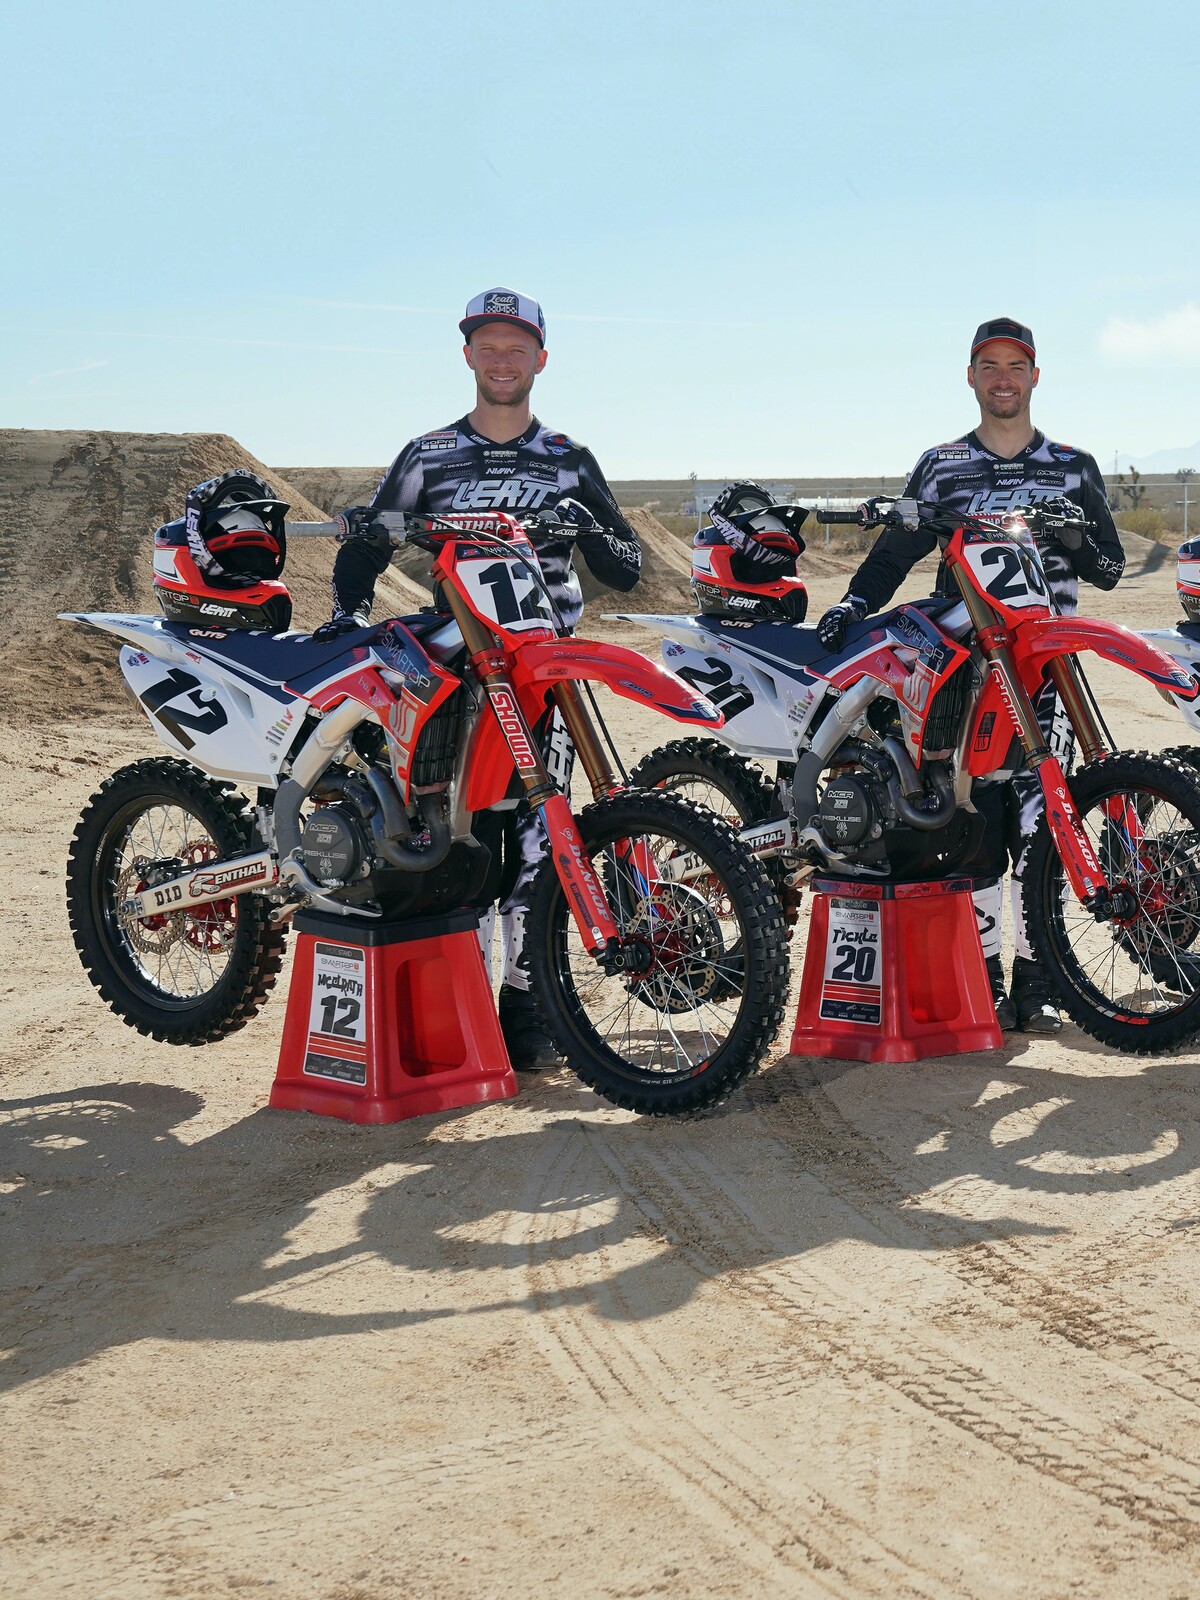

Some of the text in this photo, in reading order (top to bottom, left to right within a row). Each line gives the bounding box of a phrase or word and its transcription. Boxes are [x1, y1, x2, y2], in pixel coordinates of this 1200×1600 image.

[487, 293, 515, 304] Leatt
[451, 480, 560, 510] LEATT
[728, 596, 760, 609] LEATT
[200, 603, 237, 618] LEATT
[720, 619, 754, 629] GUTS
[189, 629, 227, 639] GUTS
[489, 691, 536, 770] SHOWA
[821, 814, 862, 823] REKLUSE
[309, 823, 339, 834] MCR
[749, 830, 785, 848] NTHAL
[1061, 801, 1098, 873] DLOP
[303, 849, 348, 860] REKLUSE
[569, 843, 610, 921] DUNLOP
[832, 944, 877, 983] 20
[319, 995, 362, 1038] 12
